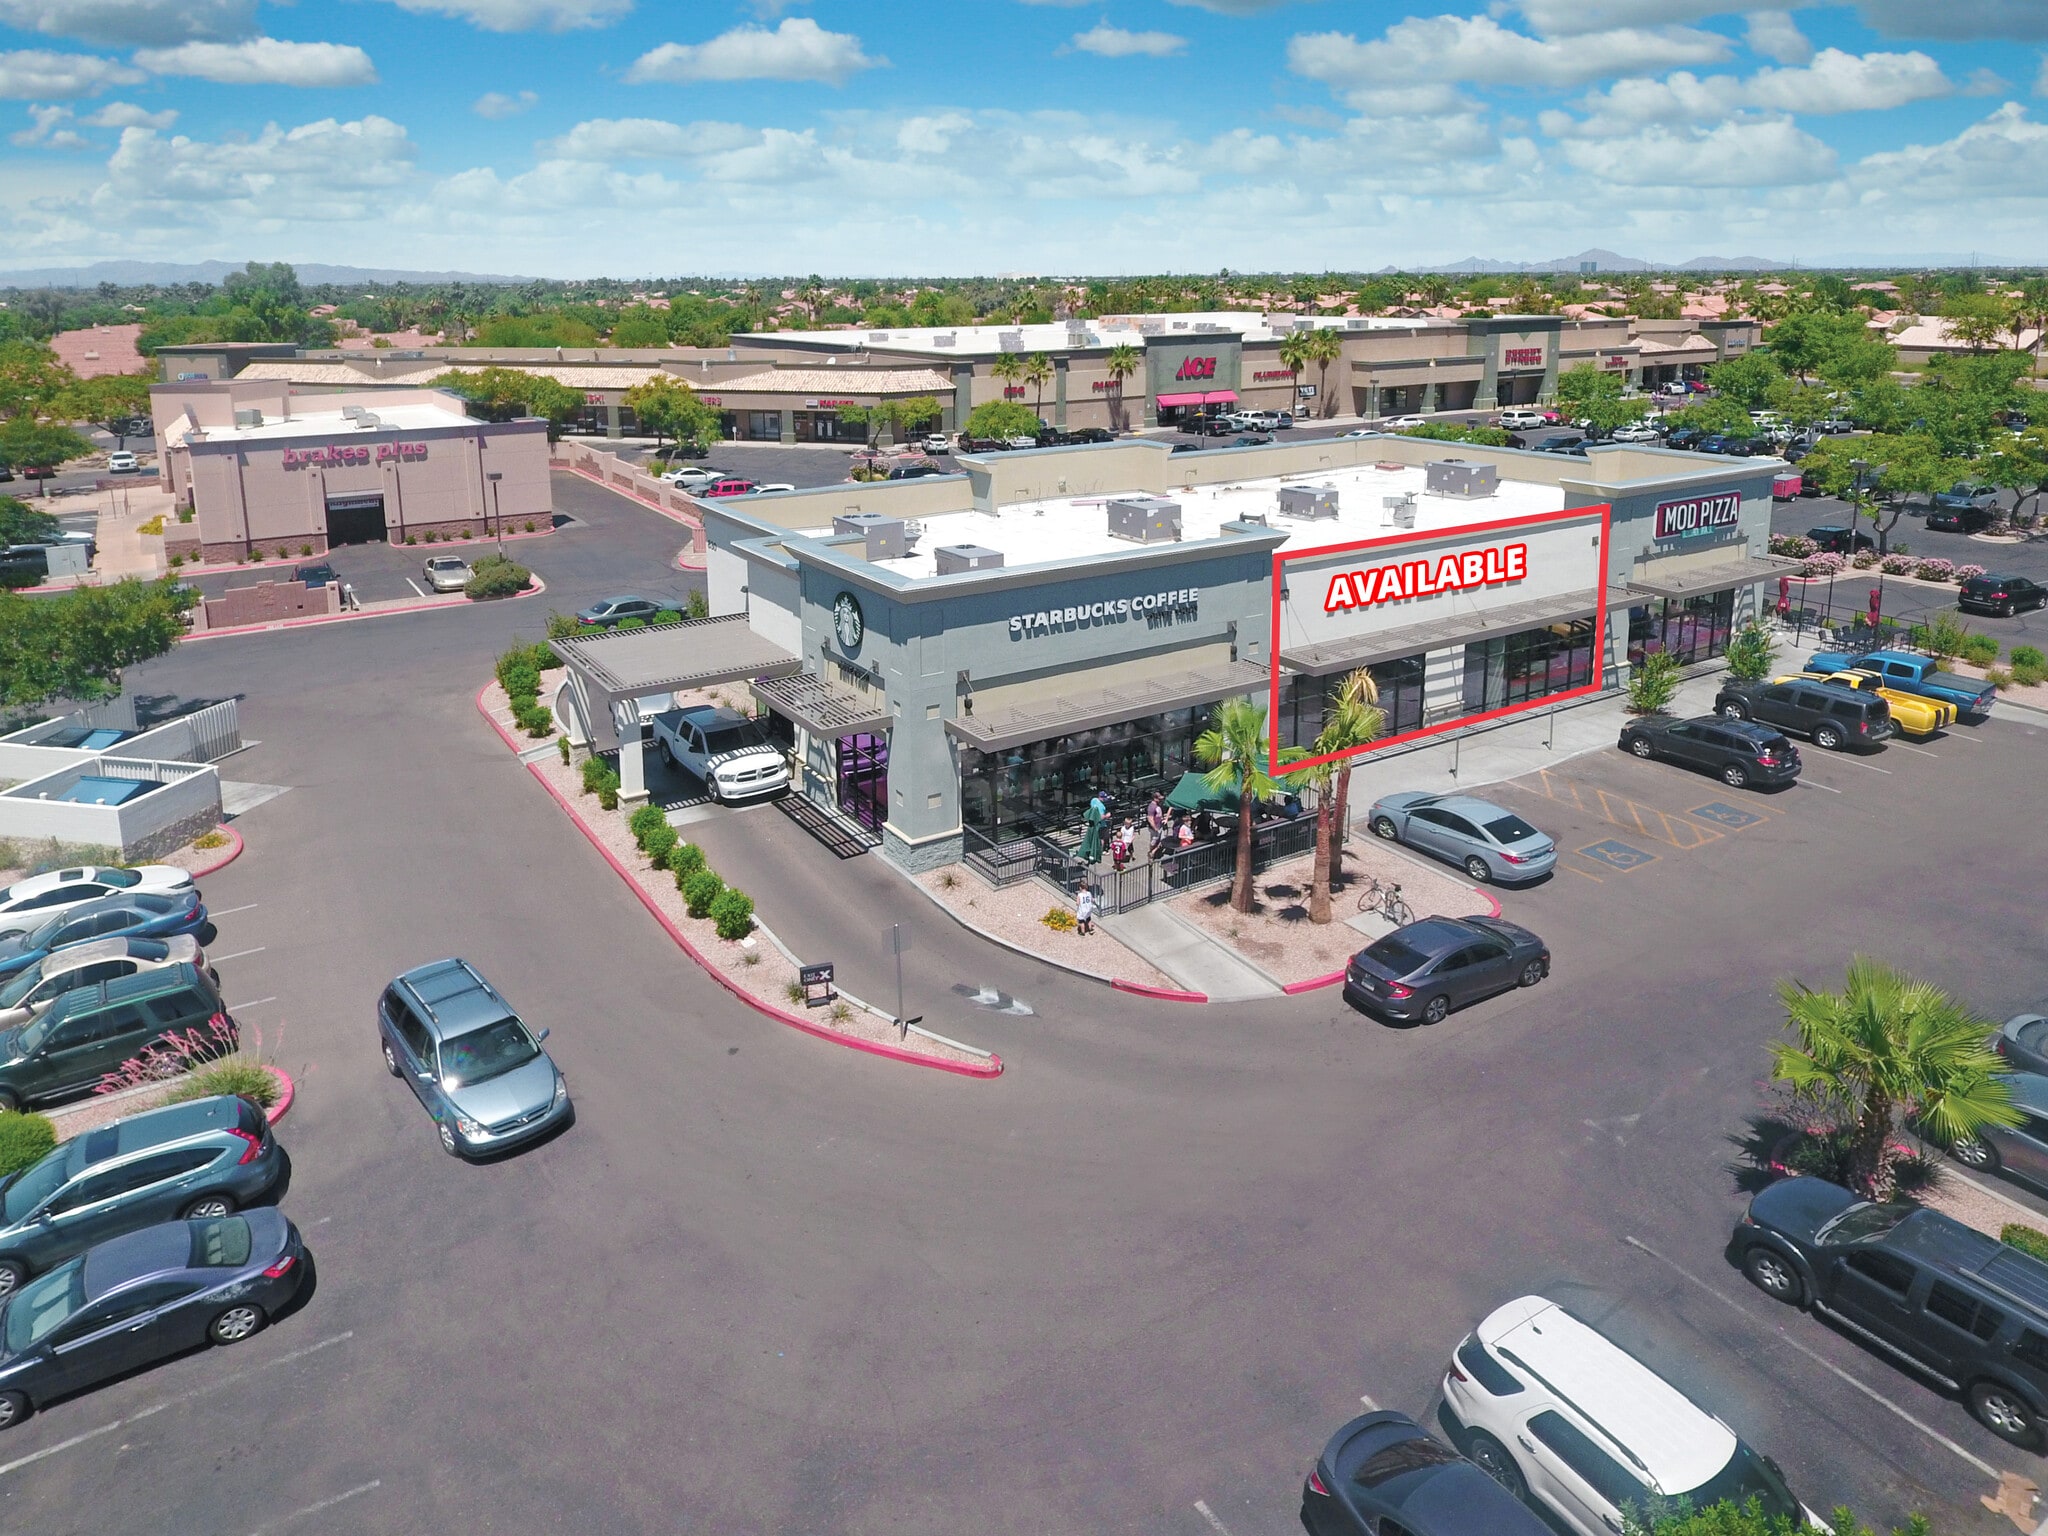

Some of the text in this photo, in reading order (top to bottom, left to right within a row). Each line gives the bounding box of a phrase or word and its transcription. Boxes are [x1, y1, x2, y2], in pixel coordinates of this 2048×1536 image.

[1176, 356, 1217, 378] ACE
[283, 440, 427, 464] brakes plus
[1664, 503, 1697, 533] MOD
[1700, 496, 1738, 526] PIZZA
[1009, 587, 1199, 632] STARBUCKS COFFEE
[1082, 896, 1090, 904] 16
